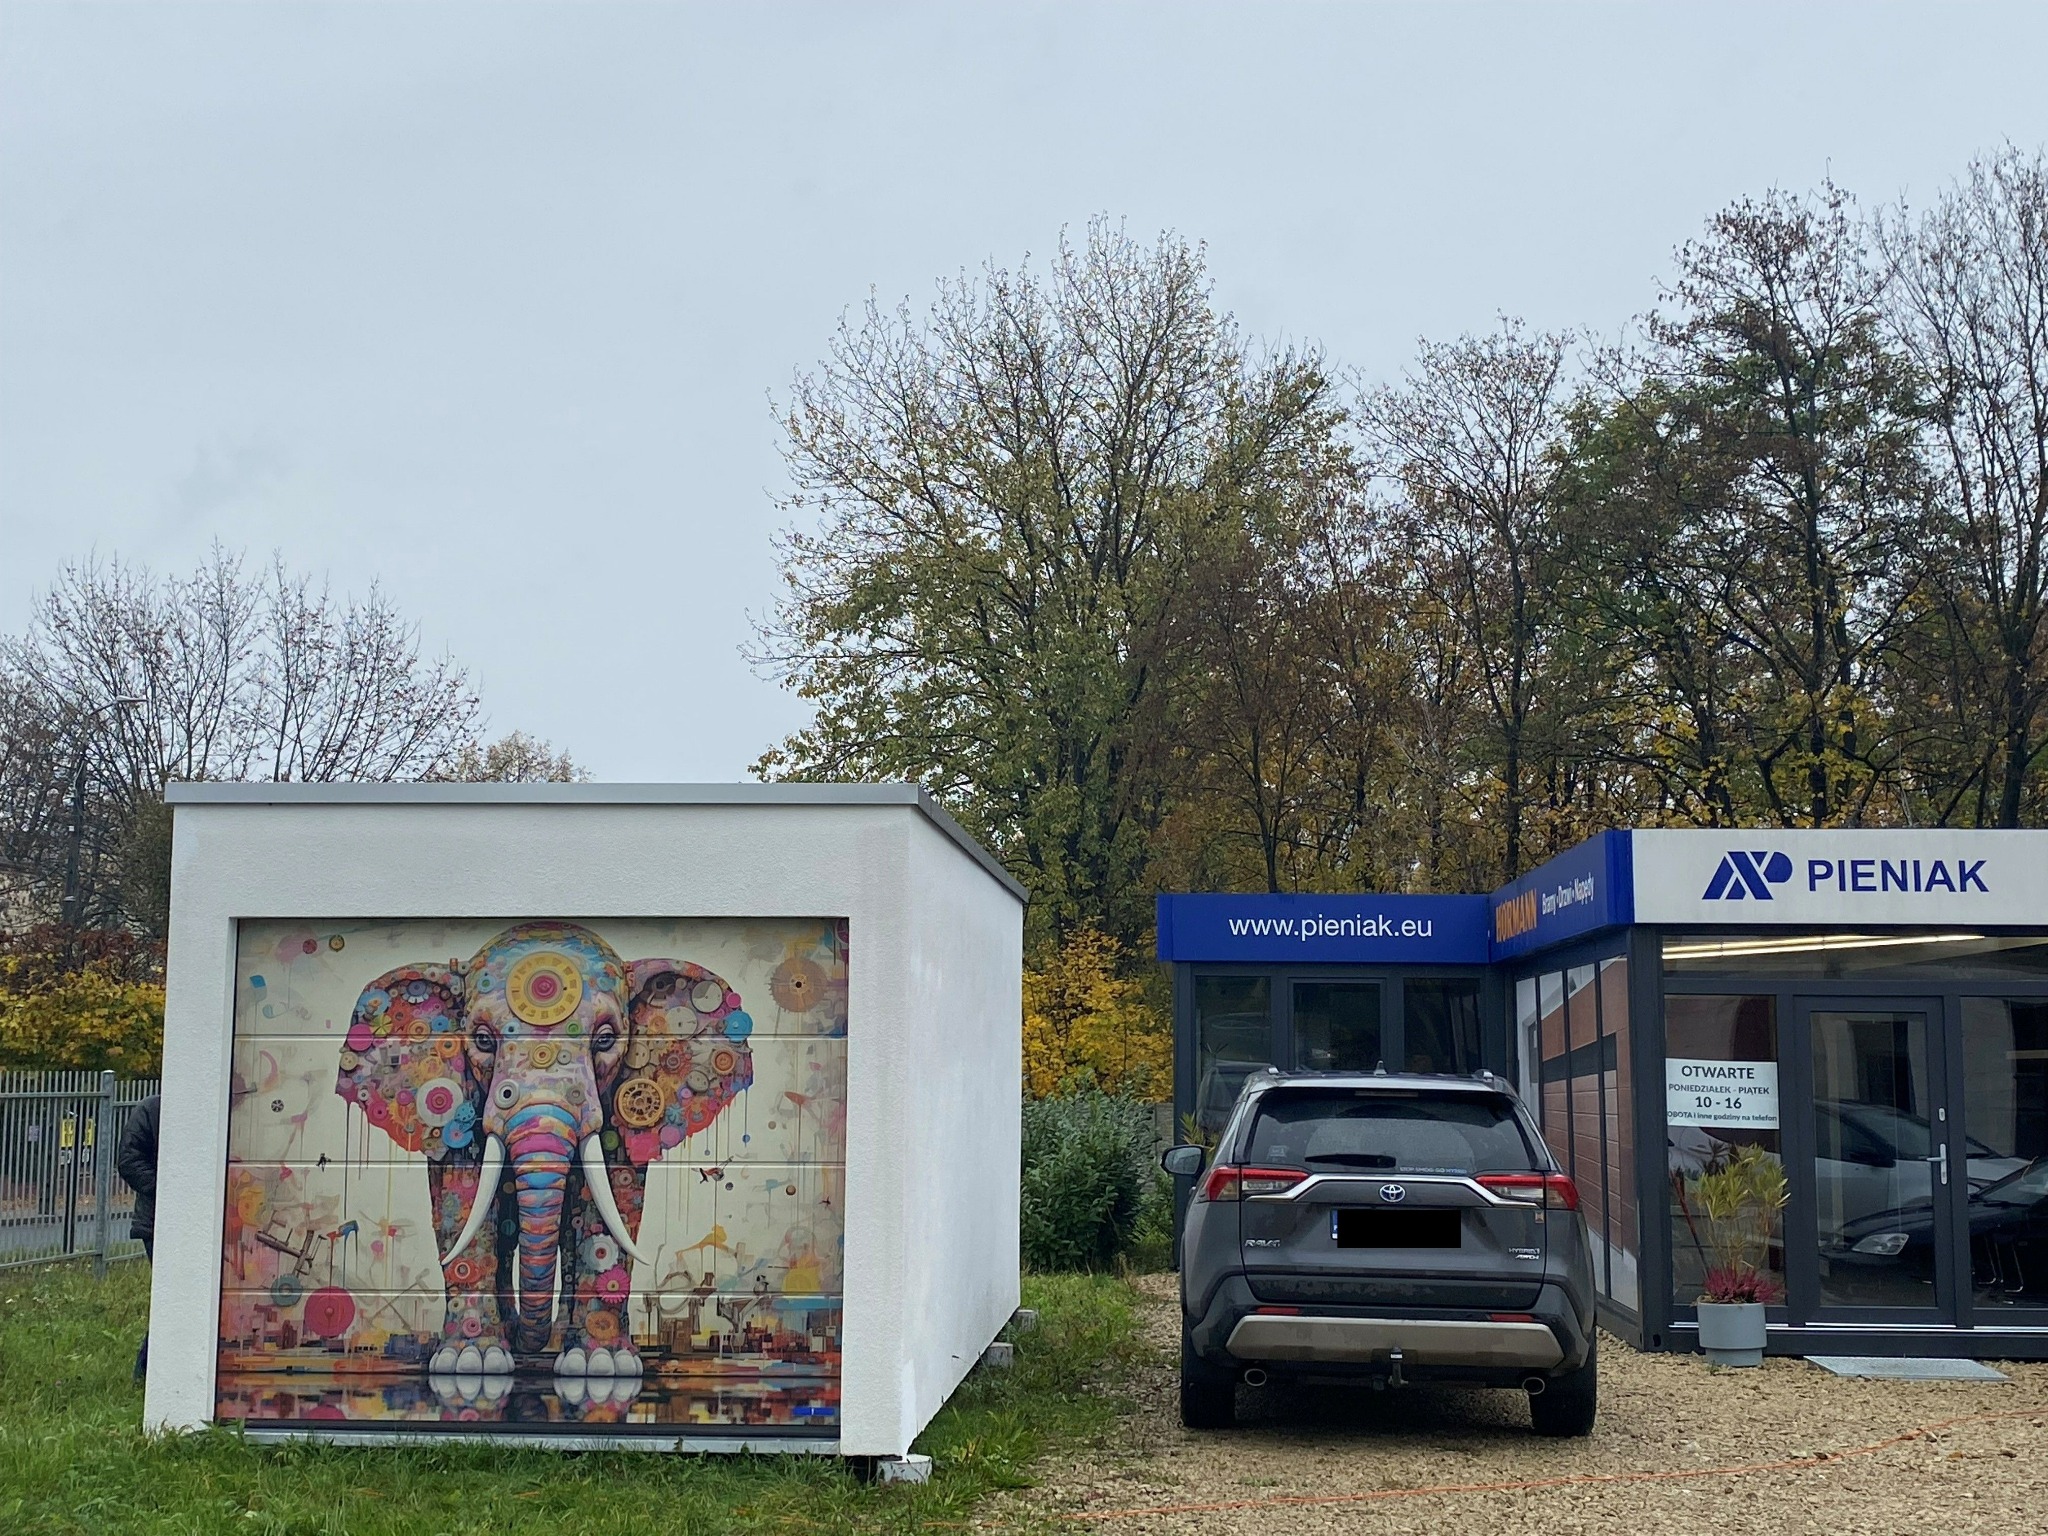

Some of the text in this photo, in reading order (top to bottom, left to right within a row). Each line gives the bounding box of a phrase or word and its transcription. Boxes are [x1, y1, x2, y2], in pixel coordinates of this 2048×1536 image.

[1807, 859, 1990, 893] PIENIAK
[1229, 914, 1433, 941] www.pieniak.eu
[1681, 1065, 1755, 1079] OTWARTE
[1668, 1083, 1731, 1094] PONIEDZIAŁEK
[1738, 1086, 1770, 1096] PIĄTEK
[1695, 1096, 1712, 1108] 10
[1725, 1097, 1742, 1109] 16
[1667, 1110, 1693, 1118] OBOTA
[1697, 1112, 1713, 1120] inne
[1713, 1113, 1741, 1122] godziny
